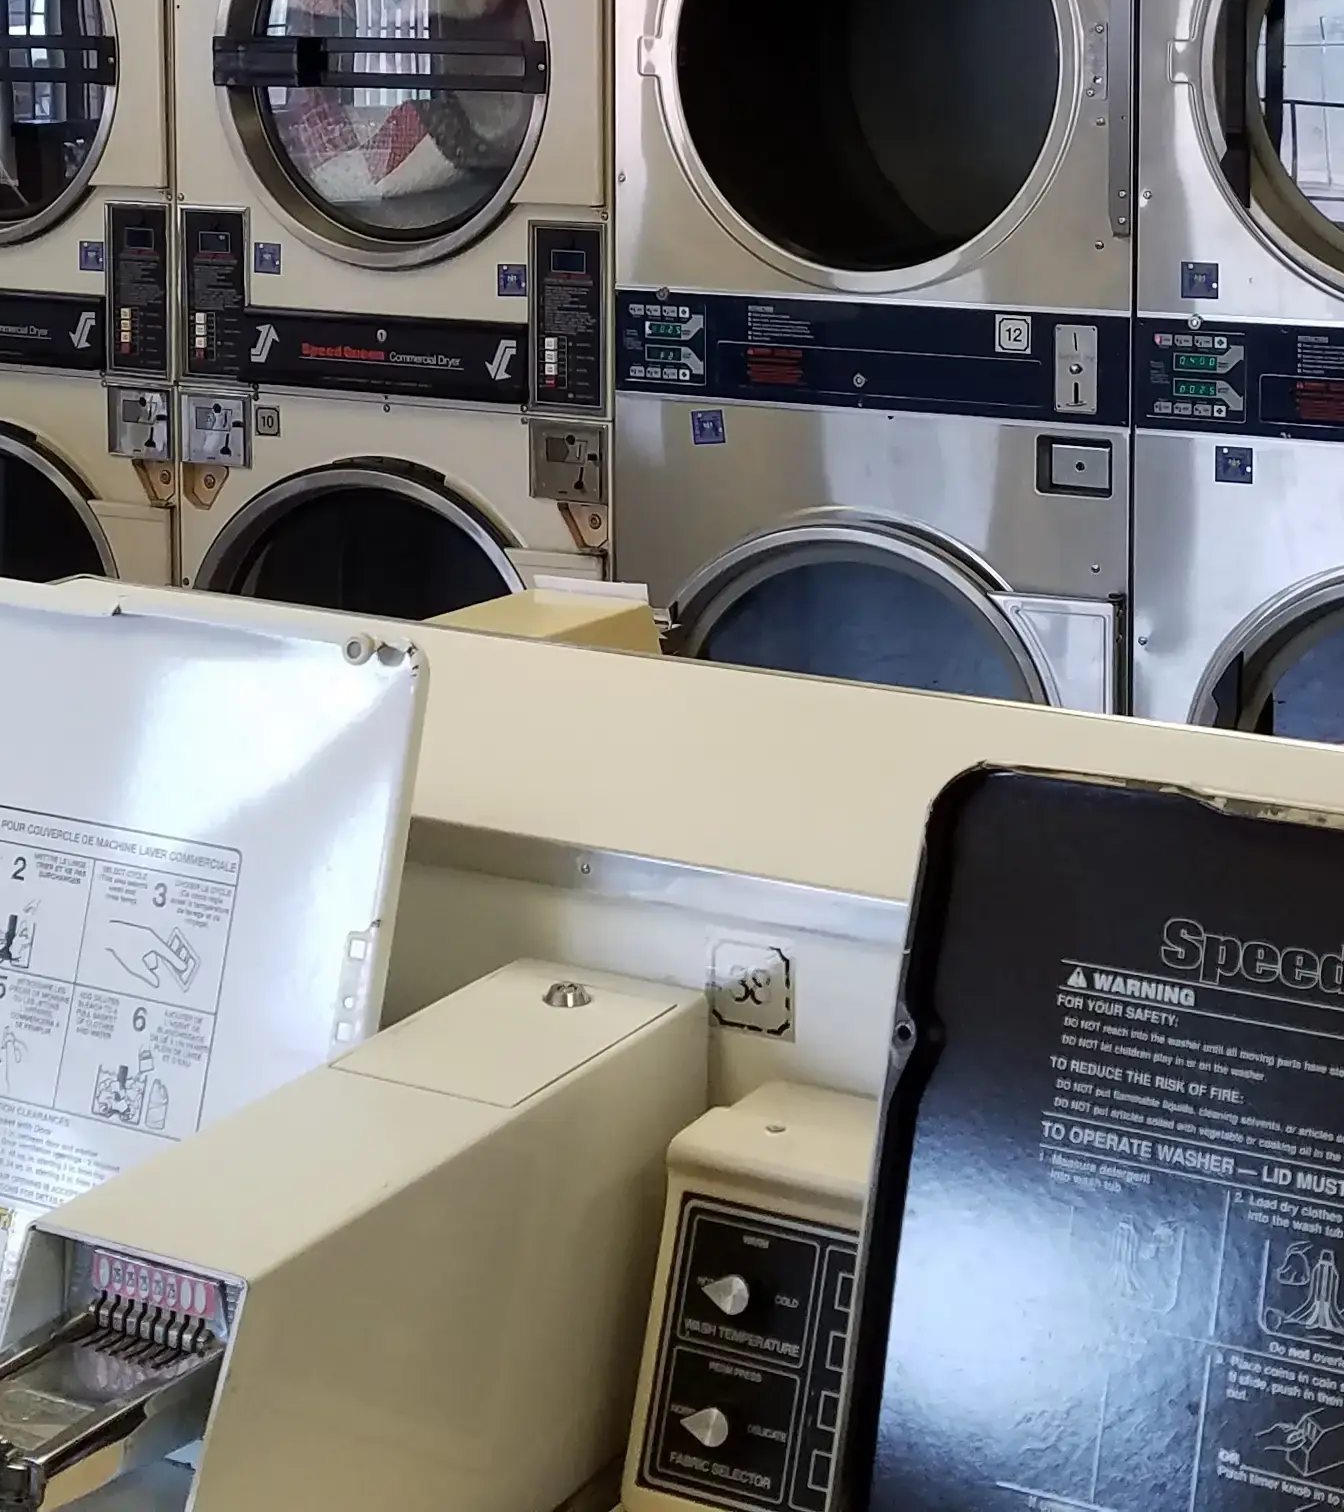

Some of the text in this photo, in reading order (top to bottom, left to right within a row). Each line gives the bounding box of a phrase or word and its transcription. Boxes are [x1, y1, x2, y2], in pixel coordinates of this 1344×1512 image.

[1005, 327, 1022, 343] 12
[389, 352, 460, 368] Commercial Dryer
[261, 415, 274, 429] 10
[12, 857, 27, 880] 2
[152, 882, 168, 907] 3
[1093, 972, 1195, 1006] WARNING
[133, 1006, 147, 1032] 6
[1057, 994, 1180, 1028] FOR YOUR SAFETY:
[1050, 1056, 1245, 1105] TO REDUCE THE RISK OF FIRE:
[1041, 1121, 1066, 1140] TO
[1069, 1127, 1152, 1158] OPERATE
[1158, 1143, 1235, 1175] WASHER
[1262, 1165, 1293, 1186] LID
